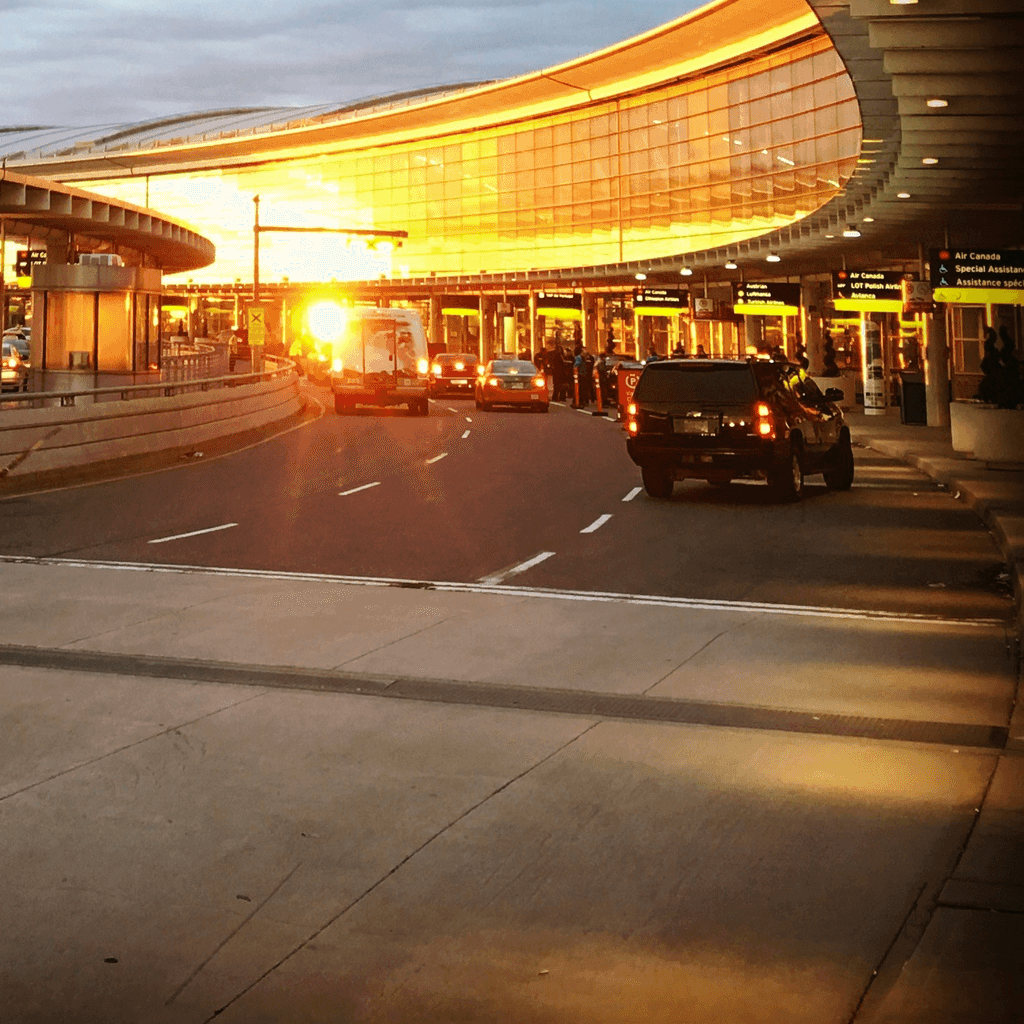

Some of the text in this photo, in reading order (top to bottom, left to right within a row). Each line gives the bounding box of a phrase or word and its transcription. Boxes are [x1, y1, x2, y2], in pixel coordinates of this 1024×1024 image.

[955, 252, 967, 260] Air
[955, 265, 986, 273] Special
[956, 278, 1024, 287] Assistance spéci
